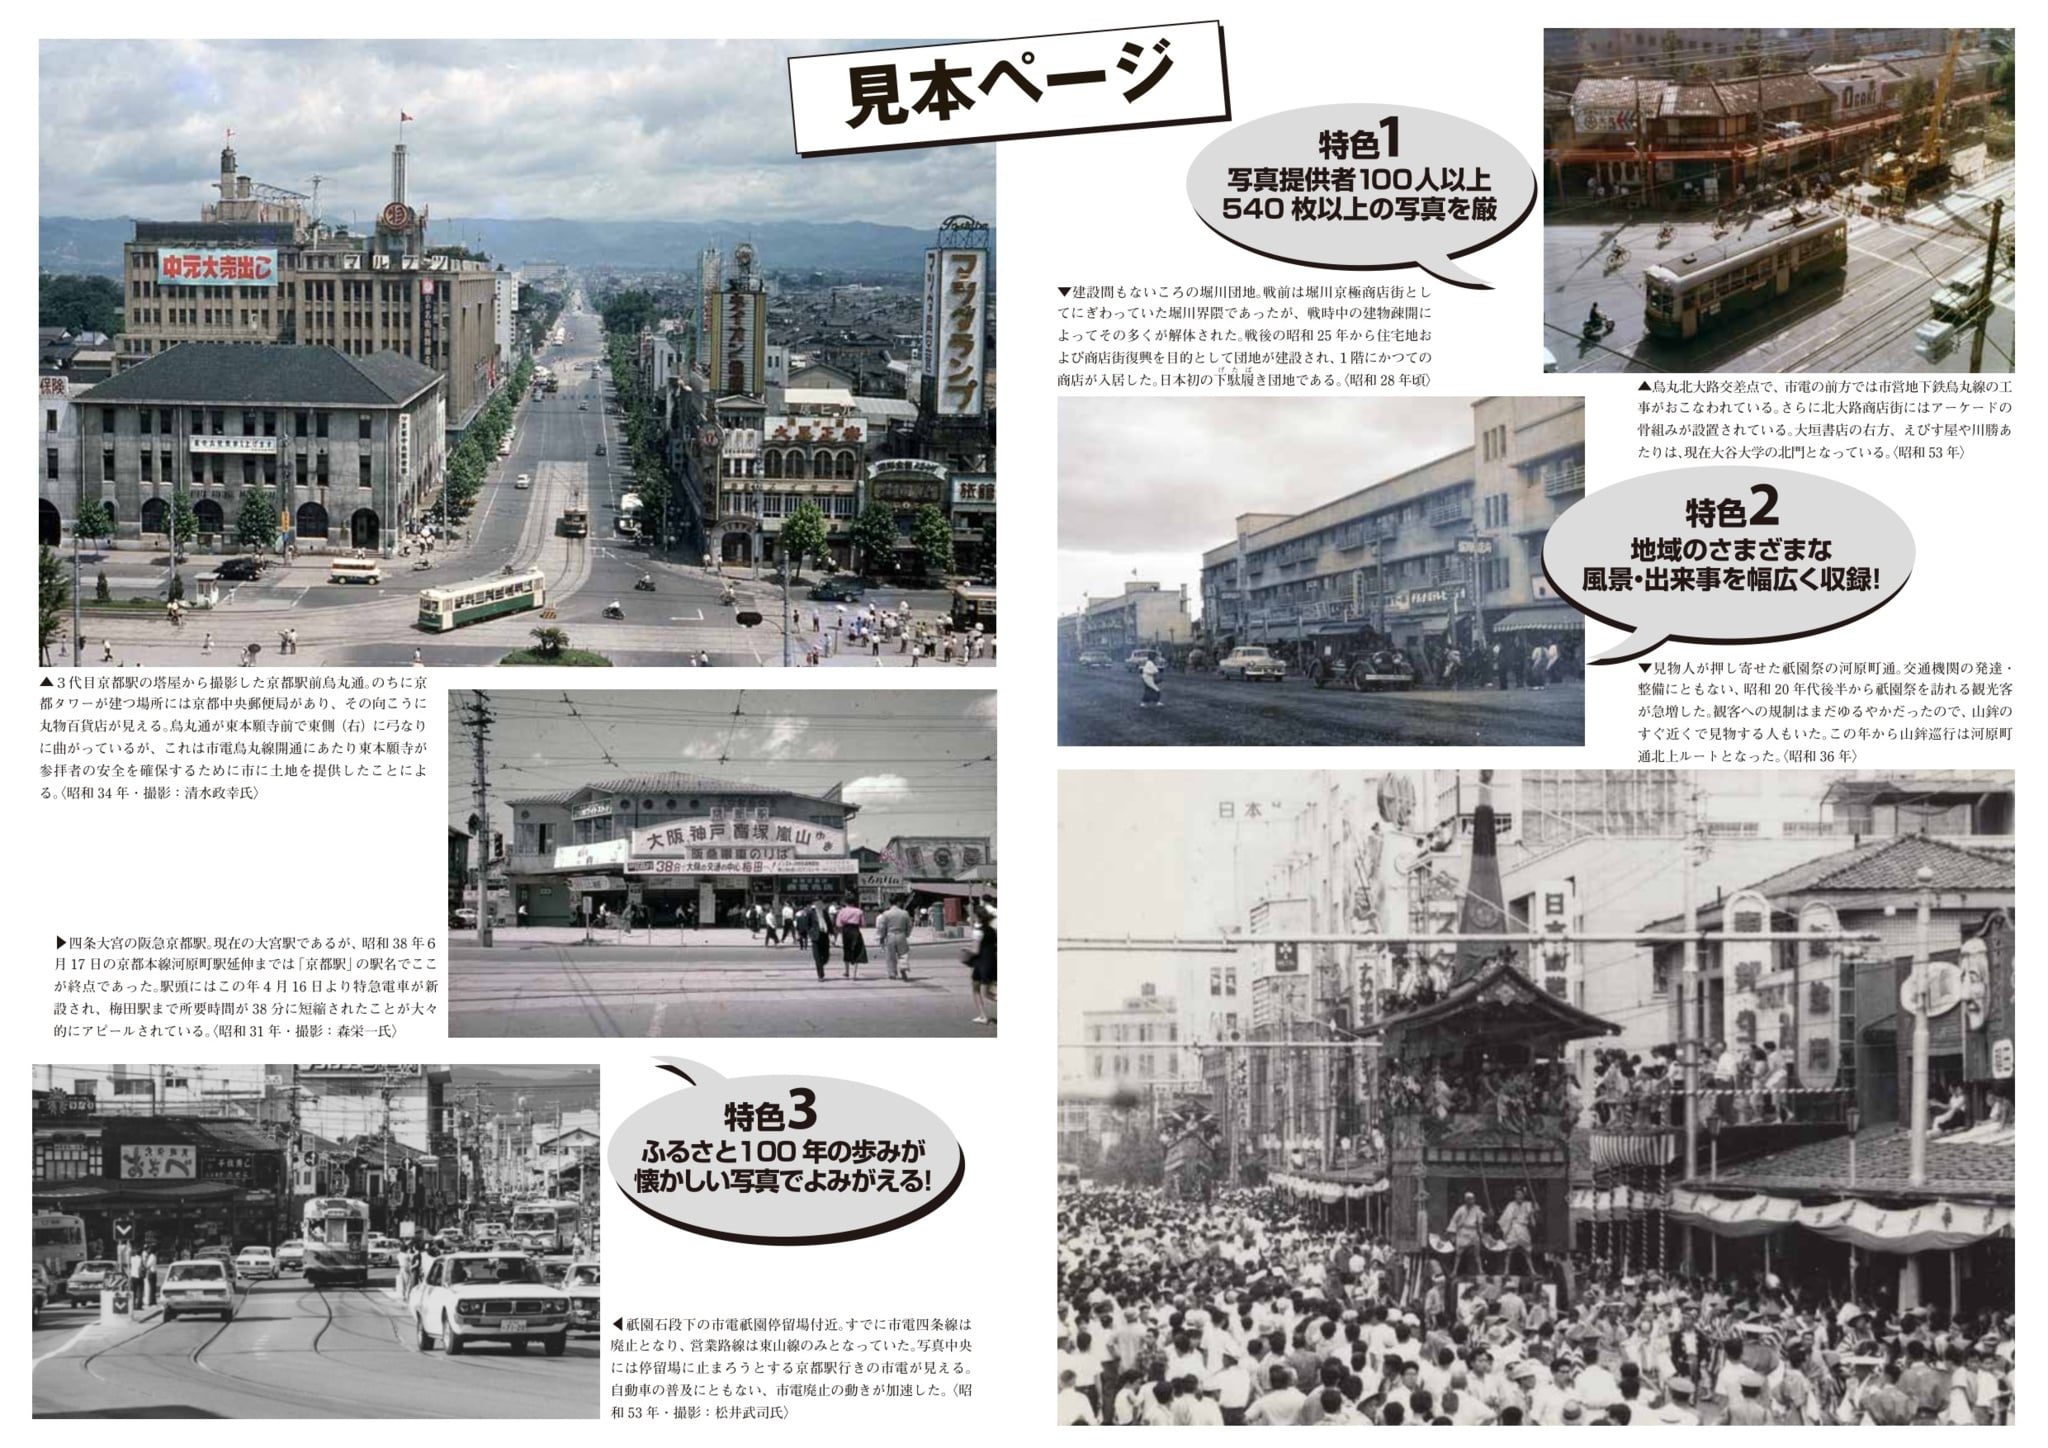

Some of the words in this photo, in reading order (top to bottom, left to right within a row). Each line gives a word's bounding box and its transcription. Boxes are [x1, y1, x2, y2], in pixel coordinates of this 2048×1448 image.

[163, 255, 272, 279] 中元大売出し
